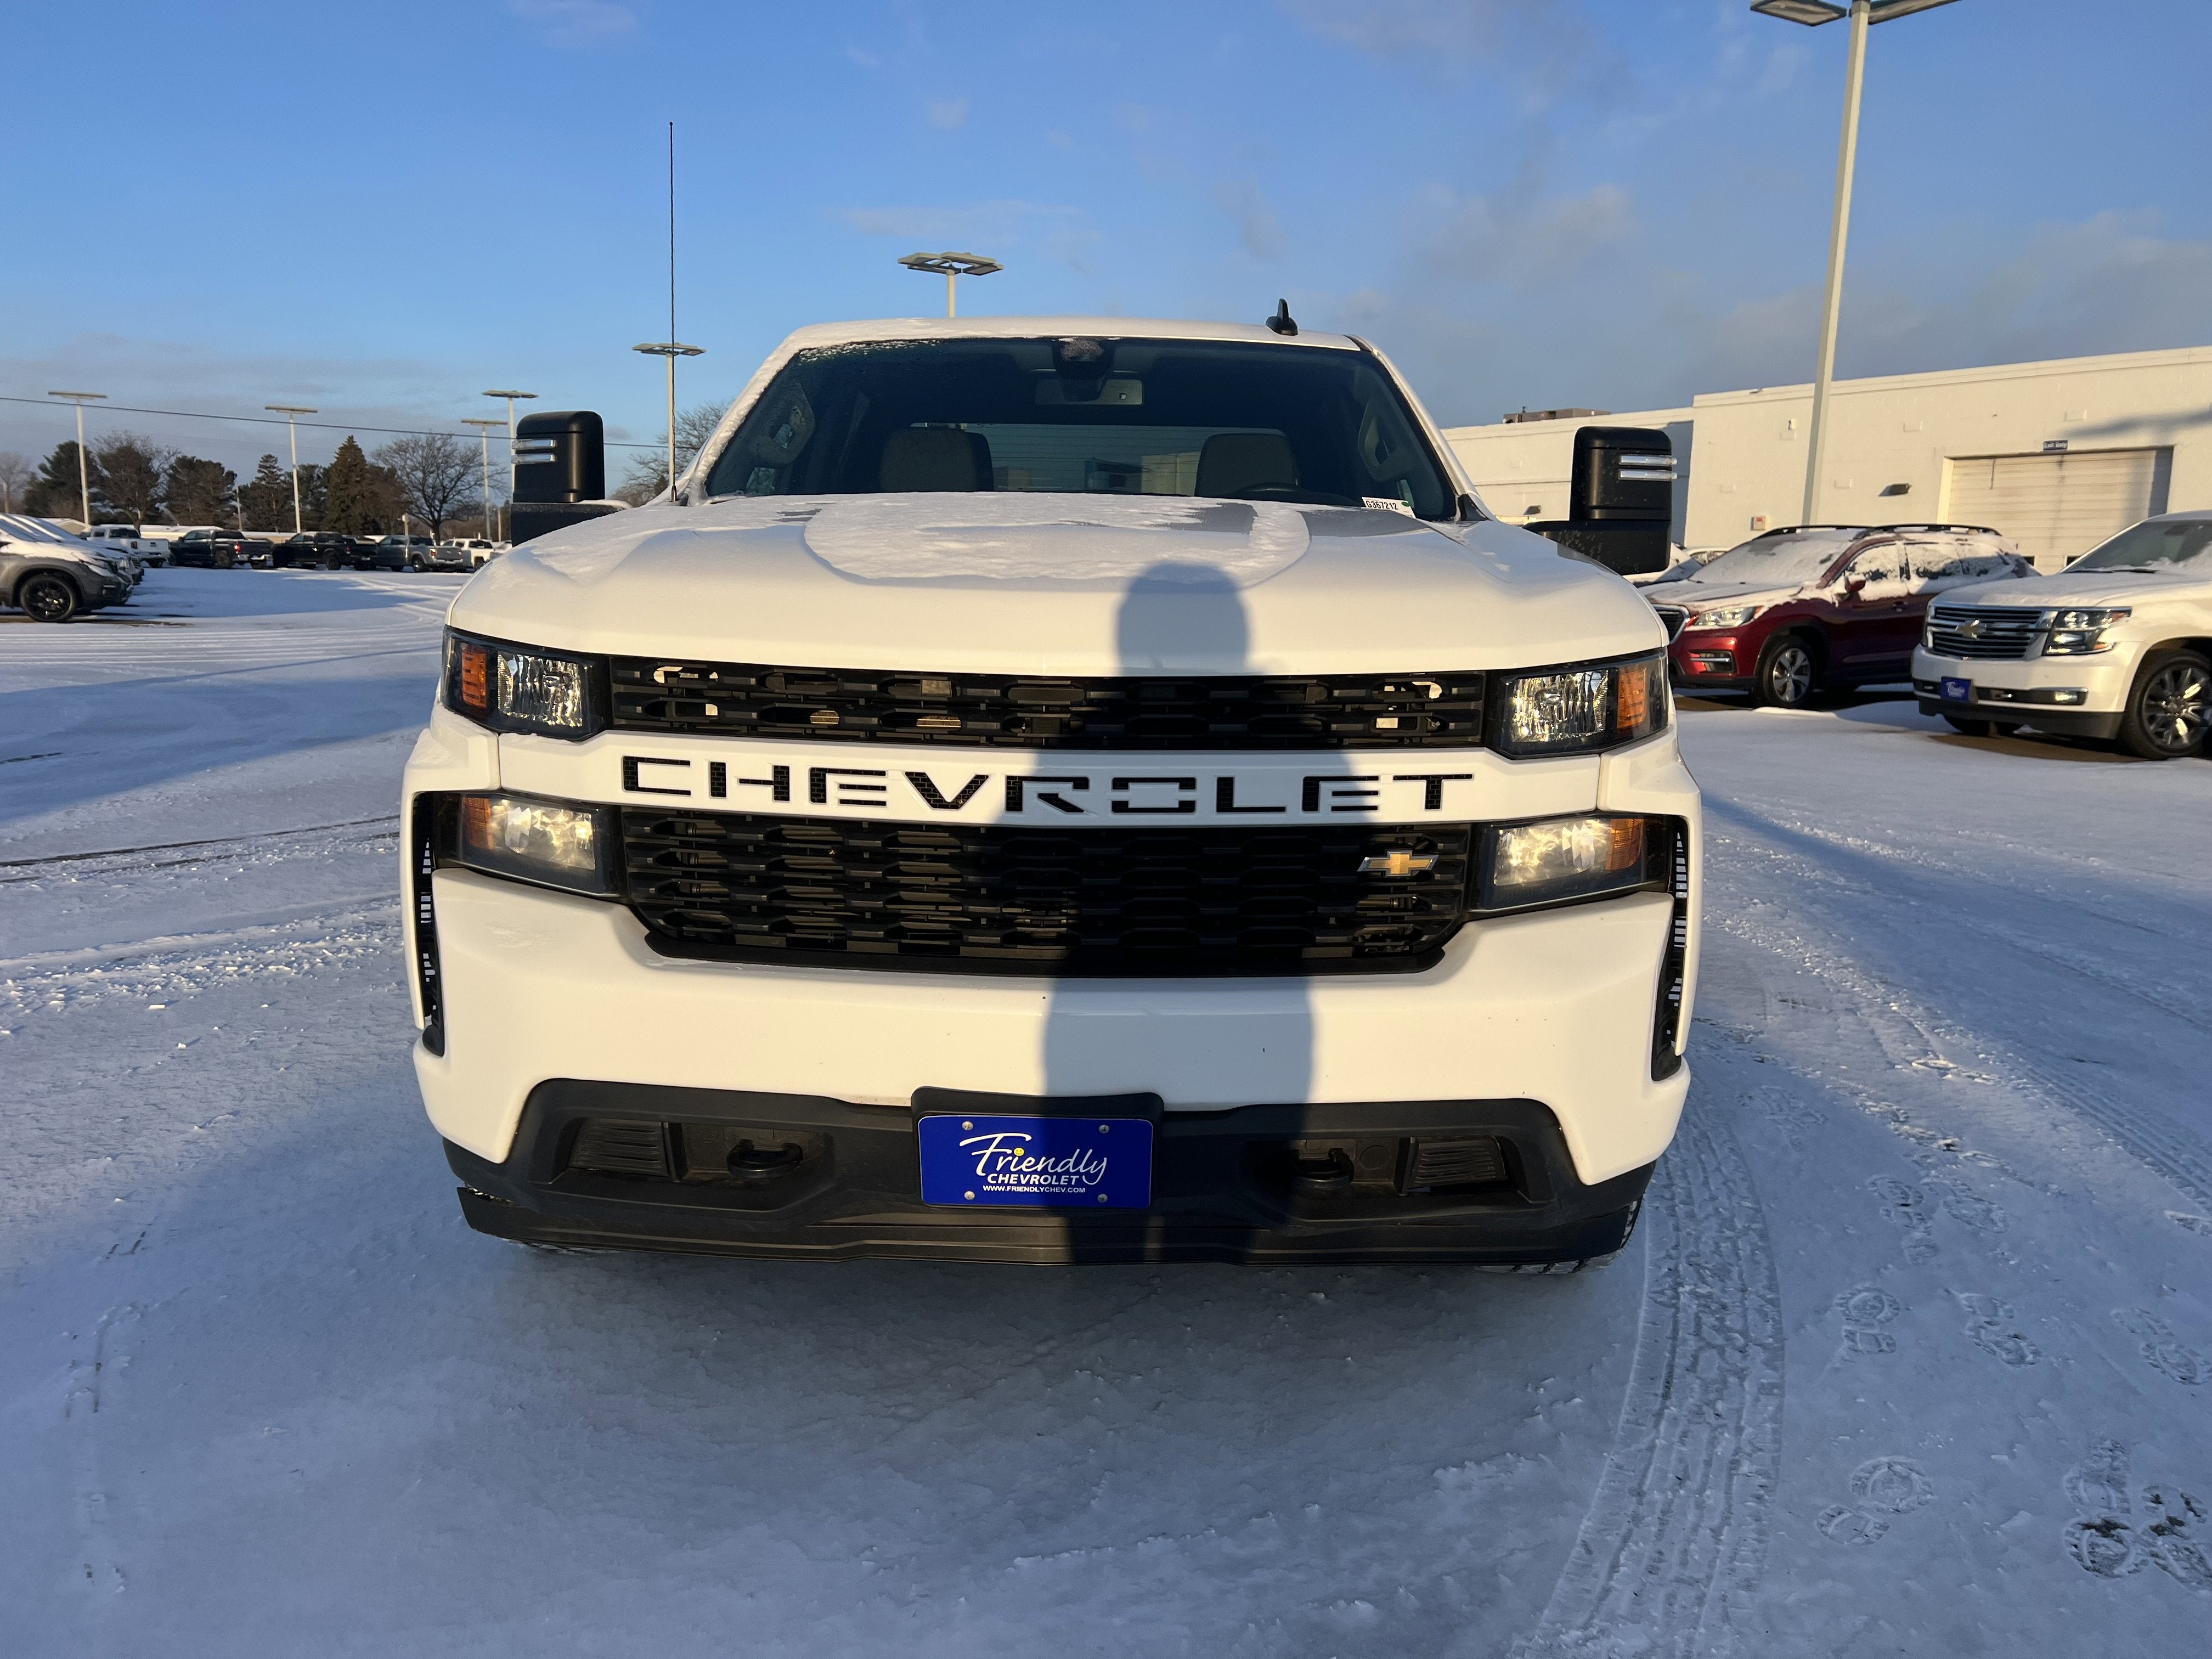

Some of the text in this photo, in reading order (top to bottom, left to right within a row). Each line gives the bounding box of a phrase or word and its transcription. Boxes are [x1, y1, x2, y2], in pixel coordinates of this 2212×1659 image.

[1365, 500, 1398, 510] G367212
[622, 755, 1474, 813] CHEVROLET
[959, 1132, 1107, 1185] Friendly
[987, 1173, 1079, 1185] CHEVROLET
